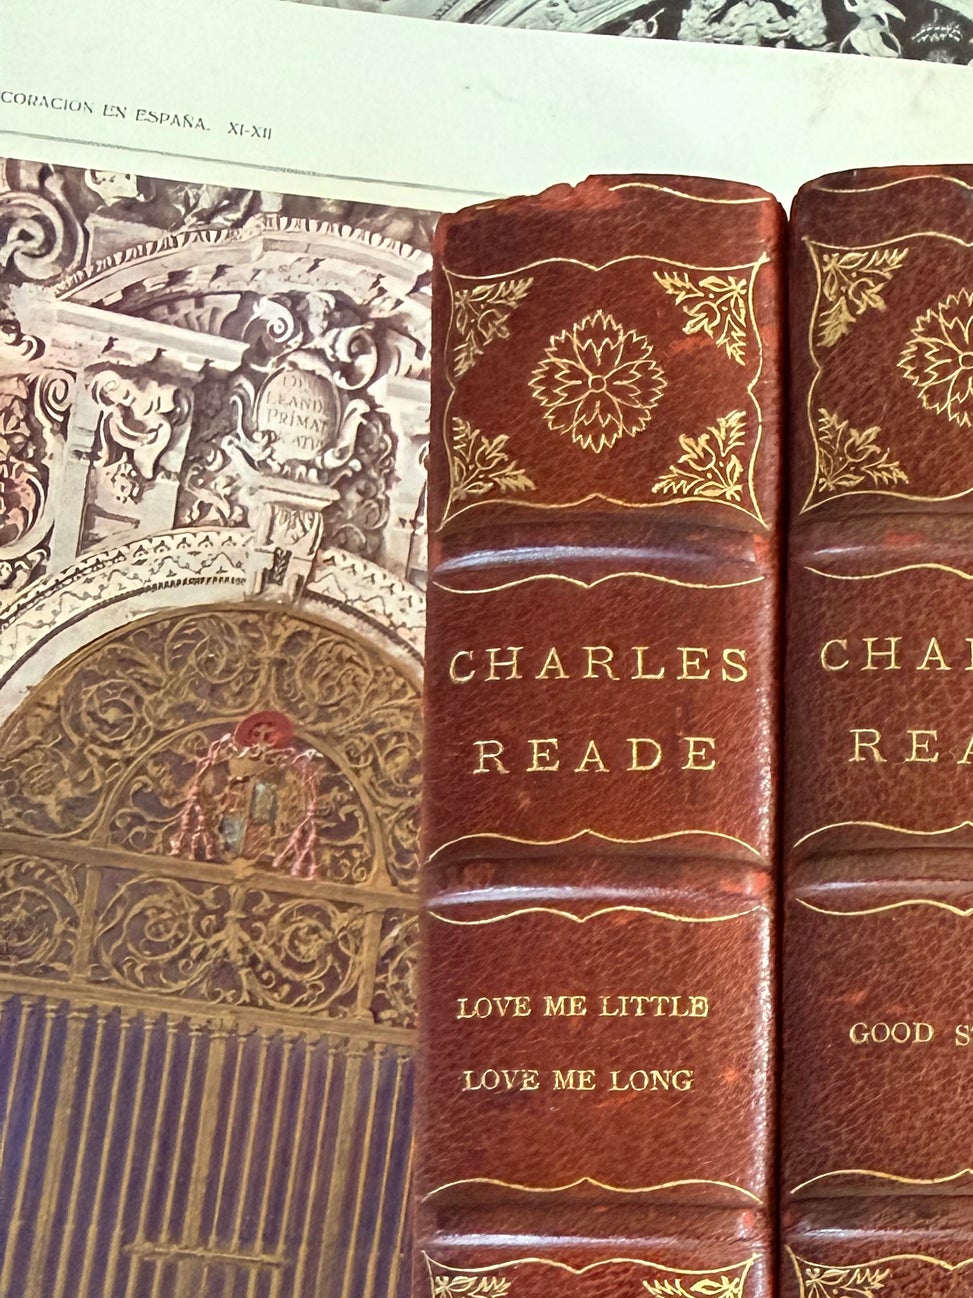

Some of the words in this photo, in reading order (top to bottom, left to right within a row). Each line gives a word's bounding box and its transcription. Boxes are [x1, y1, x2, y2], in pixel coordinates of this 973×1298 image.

[103, 104, 127, 119] EN
[228, 121, 272, 140] XI-XII
[449, 646, 748, 684] CHARLES
[472, 737, 716, 774] READE
[456, 996, 531, 1019] LOVE
[543, 995, 587, 1017] ME
[599, 995, 709, 1018] LITTLE
[849, 1022, 934, 1045] GOOD
[461, 1068, 541, 1092] LOVE
[552, 1069, 596, 1091] ME
[609, 1069, 695, 1092] LONG
